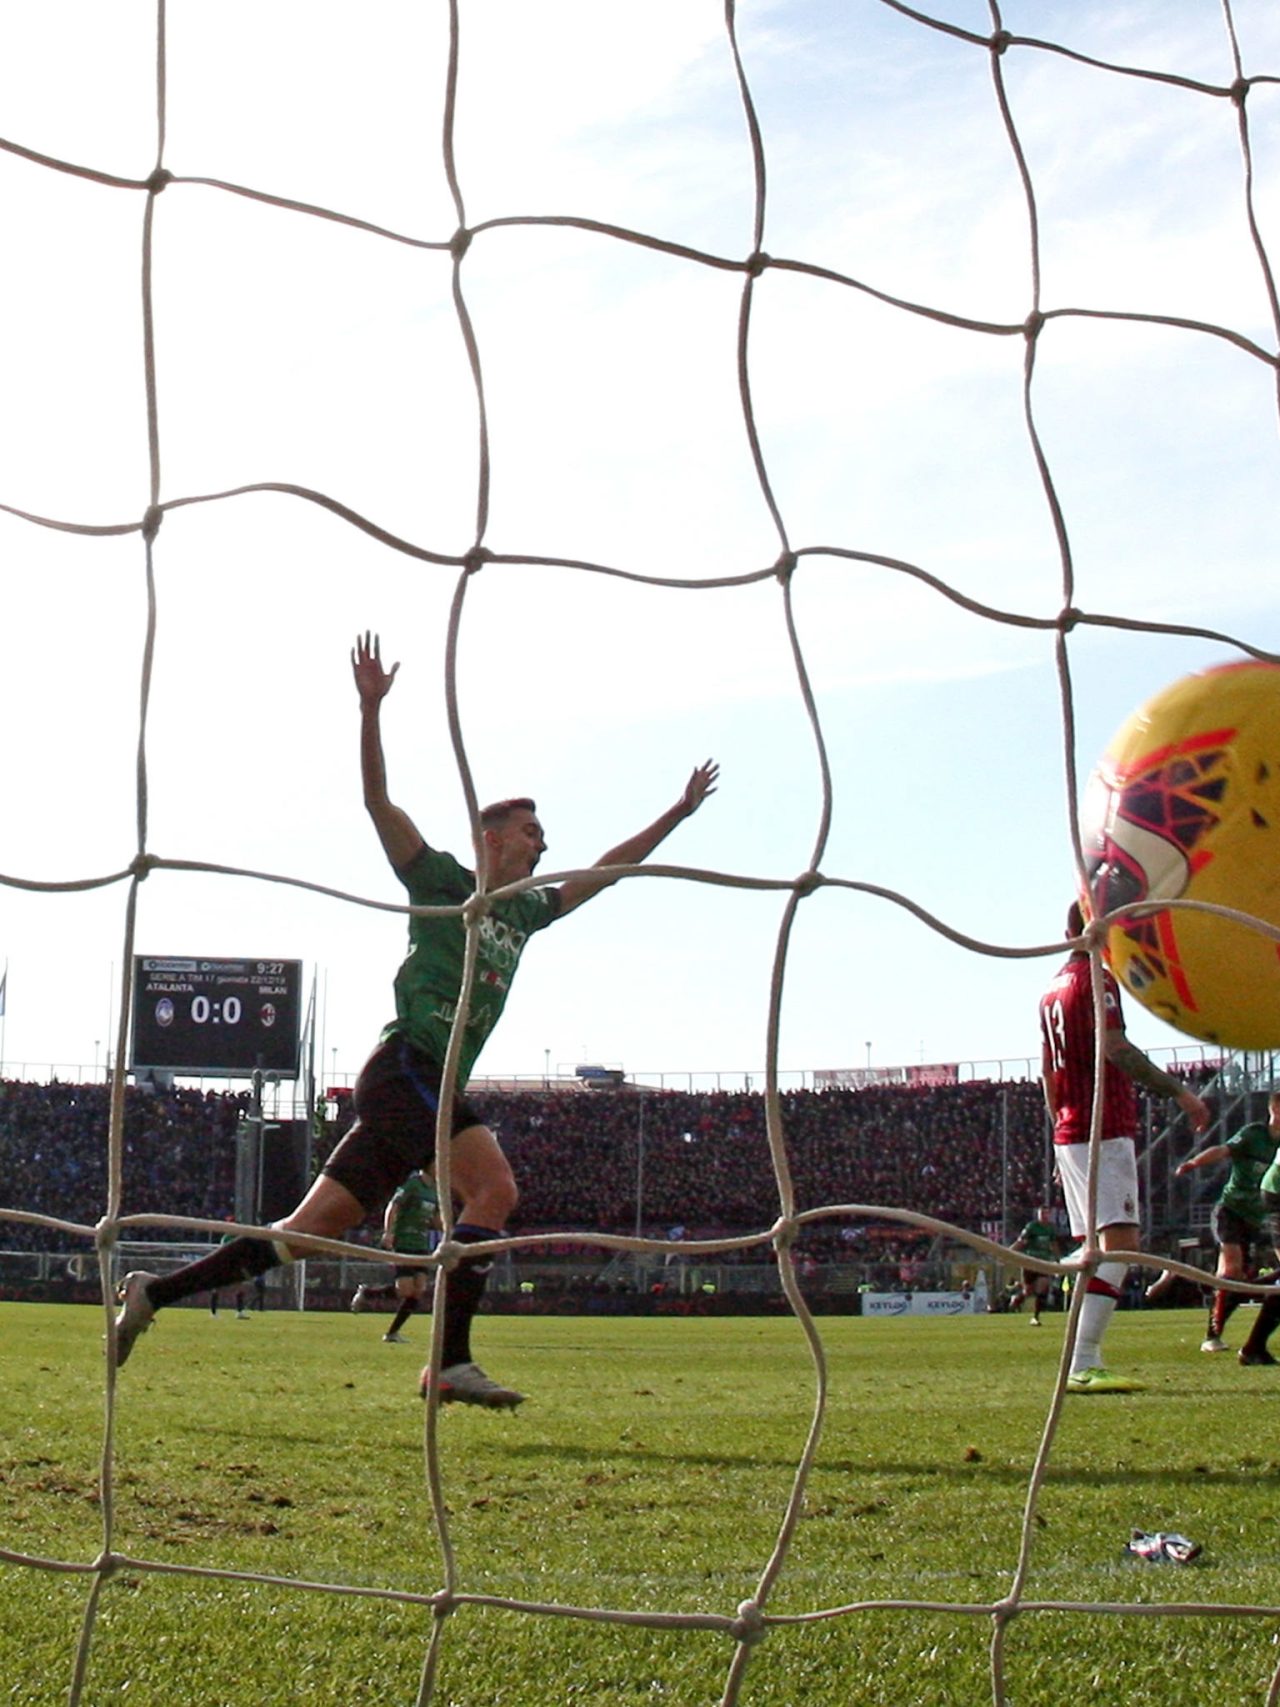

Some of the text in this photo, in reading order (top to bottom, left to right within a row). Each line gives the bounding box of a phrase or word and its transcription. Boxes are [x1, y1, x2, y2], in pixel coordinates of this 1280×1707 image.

[257, 962, 284, 974] 9:27
[178, 973, 186, 982] A
[145, 982, 194, 992] ATALANTA
[258, 985, 287, 995] MILAN
[190, 995, 241, 1024] 0:0
[1044, 999, 1066, 1072] 13
